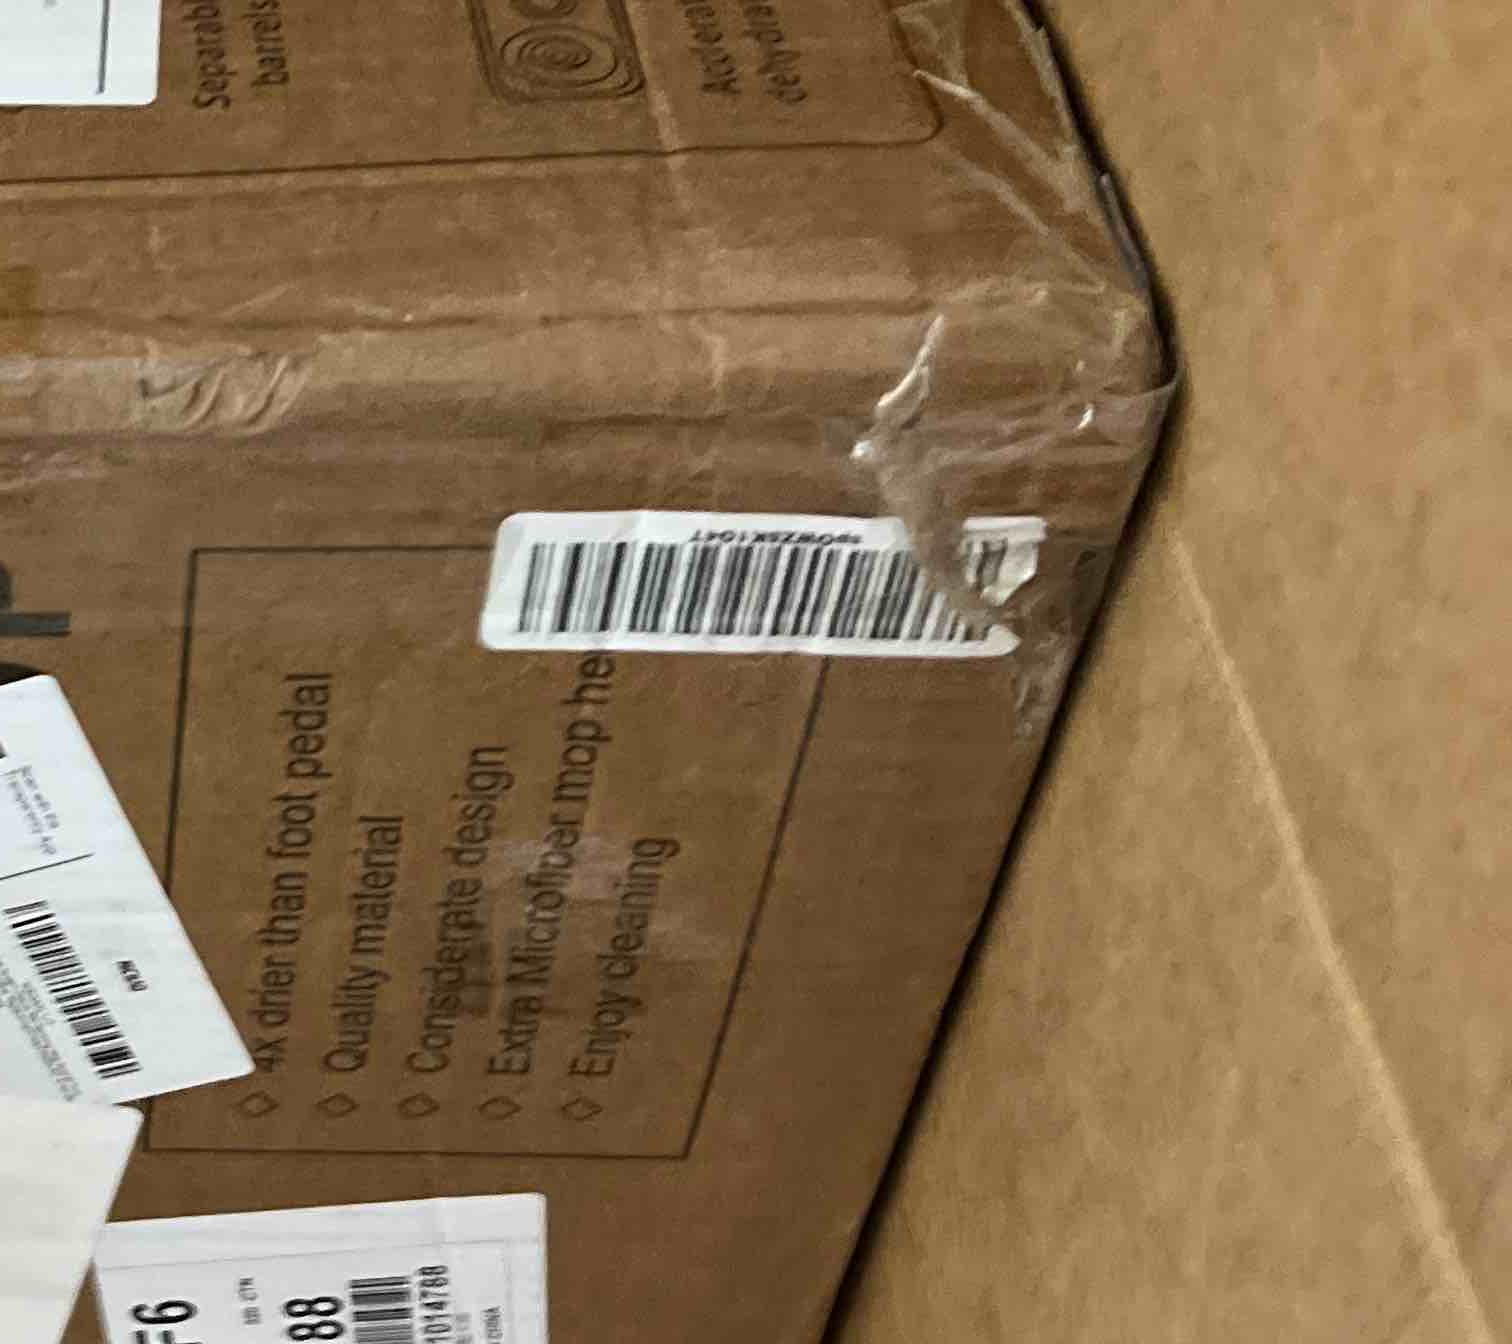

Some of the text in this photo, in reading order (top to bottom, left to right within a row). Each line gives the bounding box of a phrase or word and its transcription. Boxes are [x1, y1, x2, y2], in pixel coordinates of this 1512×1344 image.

[243, 0, 290, 87] barrels
[277, 672, 333, 778] pedal
[556, 718, 612, 802] mop
[266, 793, 319, 859] foot
[257, 872, 308, 947] than
[410, 746, 515, 1074] Considerate design
[505, 814, 579, 983] Microfiber
[323, 815, 404, 1074] Quality material
[570, 838, 681, 1077] Enjoy cleaning
[250, 954, 294, 1026] drier
[489, 995, 547, 1074] Extra
